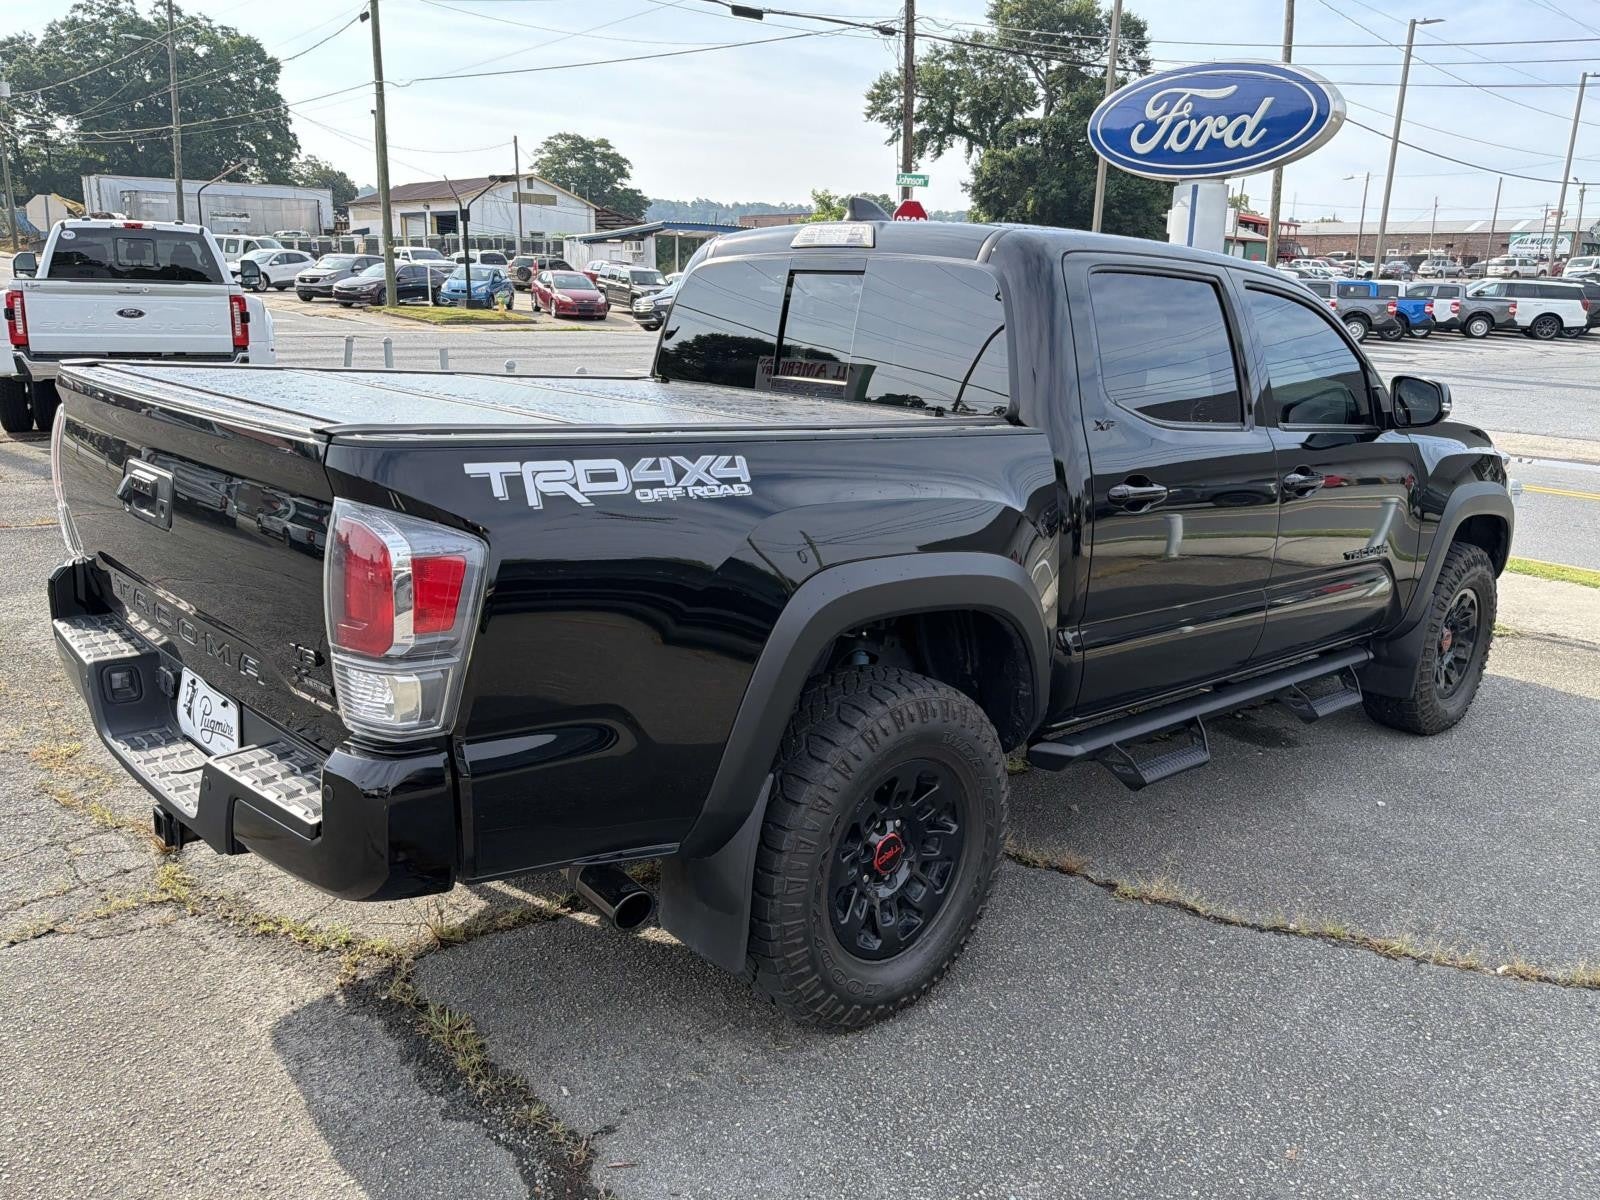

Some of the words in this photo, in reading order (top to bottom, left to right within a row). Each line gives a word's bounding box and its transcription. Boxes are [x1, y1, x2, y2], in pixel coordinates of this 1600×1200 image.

[1130, 84, 1275, 154] Ford
[896, 175, 925, 186] Johnson
[1529, 237, 1565, 246] WEATR
[463, 458, 632, 510] TRD
[635, 486, 685, 503] OFF
[688, 483, 752, 500] ROAD
[113, 572, 266, 687] TACOMA
[199, 695, 235, 744] Pugmire
[877, 846, 901, 865] TRD
